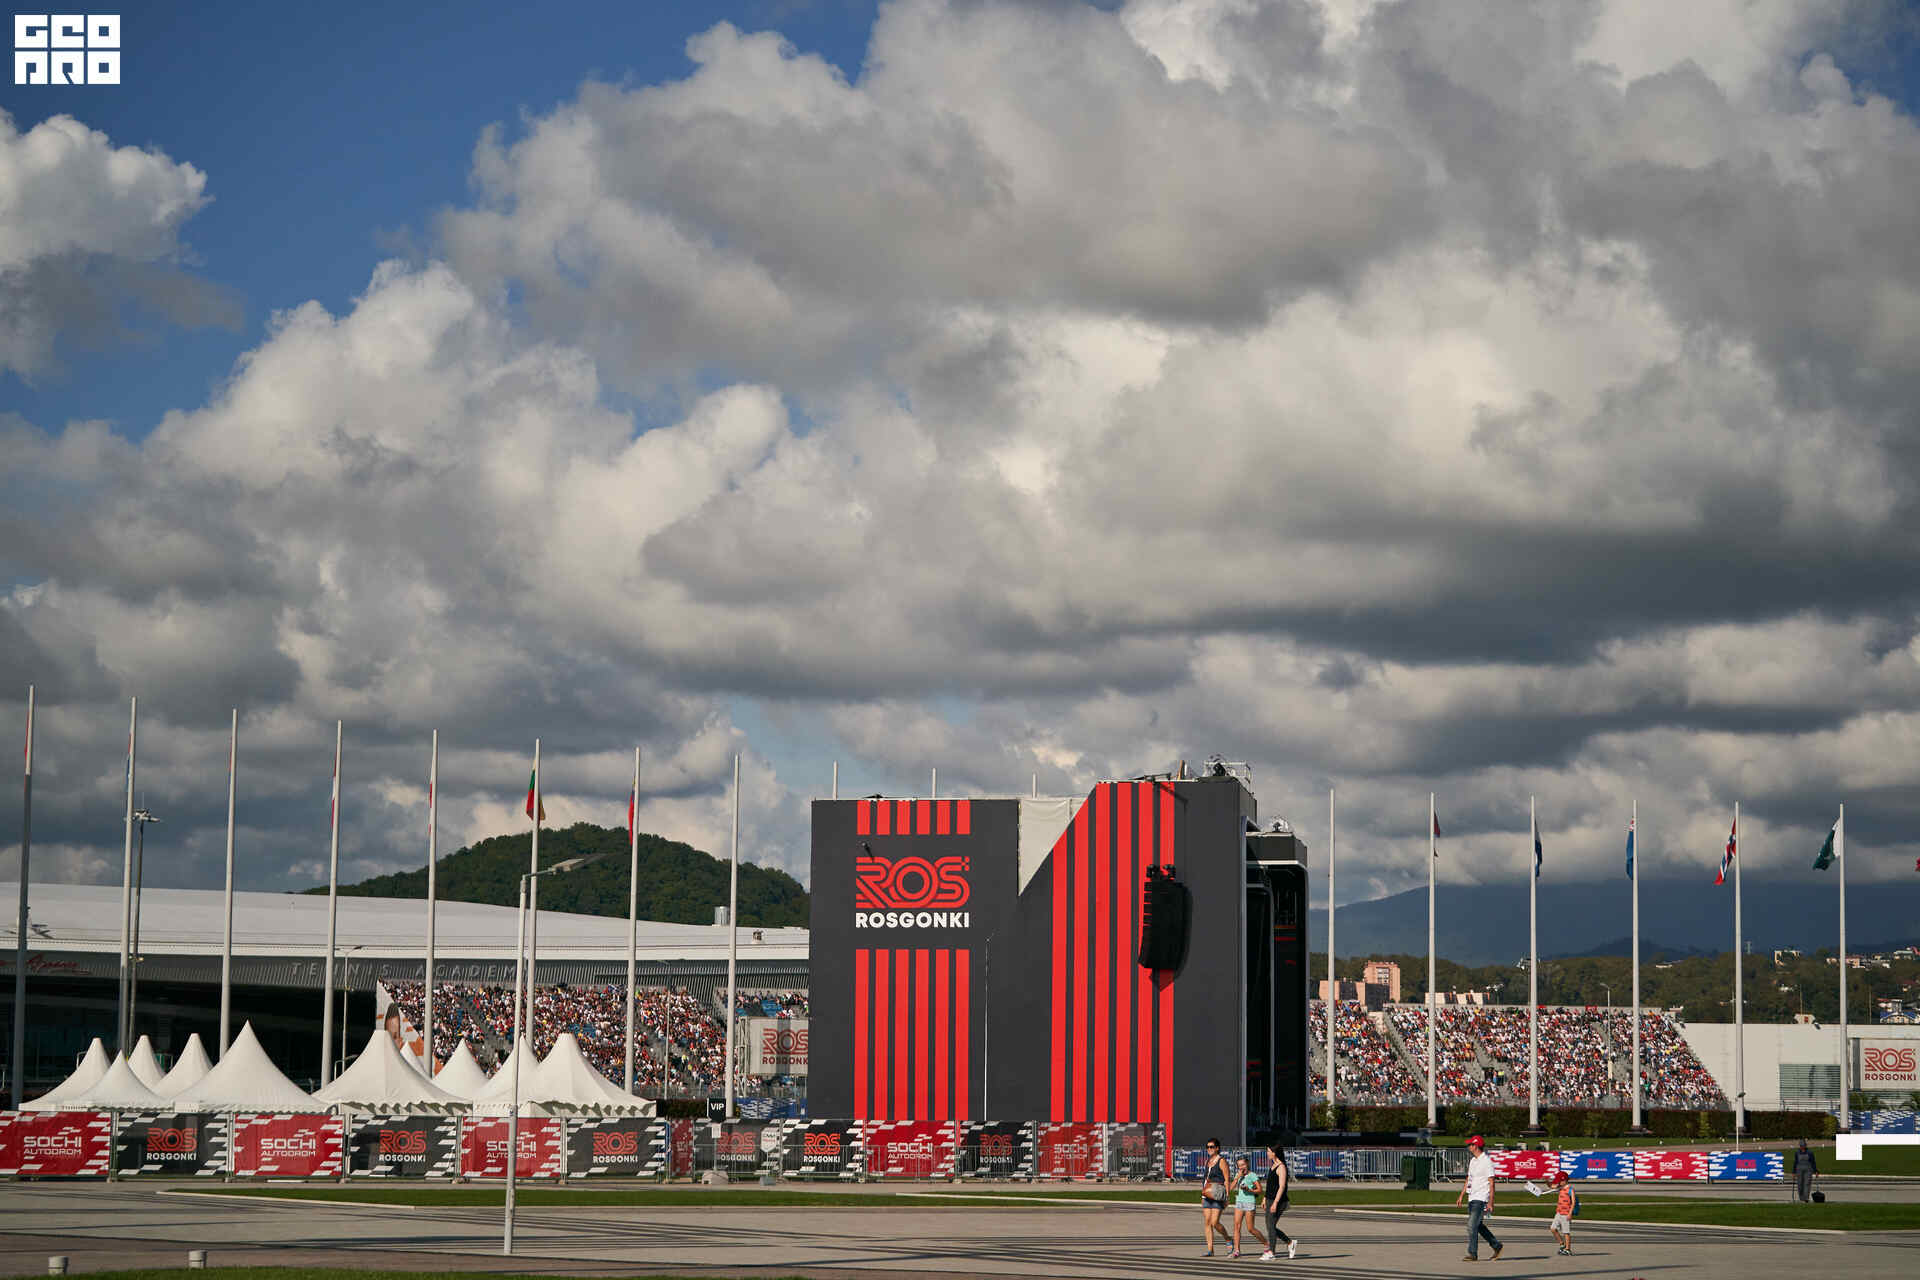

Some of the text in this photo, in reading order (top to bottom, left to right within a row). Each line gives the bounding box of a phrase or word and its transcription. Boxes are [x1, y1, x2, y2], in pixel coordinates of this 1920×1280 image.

[855, 856, 970, 909] ROS
[855, 912, 970, 929] ROSGONKI
[763, 1028, 808, 1055] ROS
[1864, 1048, 1916, 1072] ROS
[1864, 1073, 1917, 1081] ROSGONKI
[710, 1102, 725, 1111] VIP
[23, 1136, 82, 1148] SOCHI
[147, 1128, 197, 1152] ROS
[260, 1138, 317, 1150] SOCHI
[379, 1130, 427, 1154] ROS
[593, 1131, 639, 1155] ROS
[804, 1133, 841, 1155] ROS
[887, 1142, 934, 1153] SOCHI
[146, 1153, 197, 1161] ROSGONKI
[378, 1154, 426, 1163] ROSGONKI
[592, 1155, 639, 1163] ROSGONKI
[717, 1154, 756, 1162] OSGONKI
[803, 1155, 841, 1163] ROSGONKI
